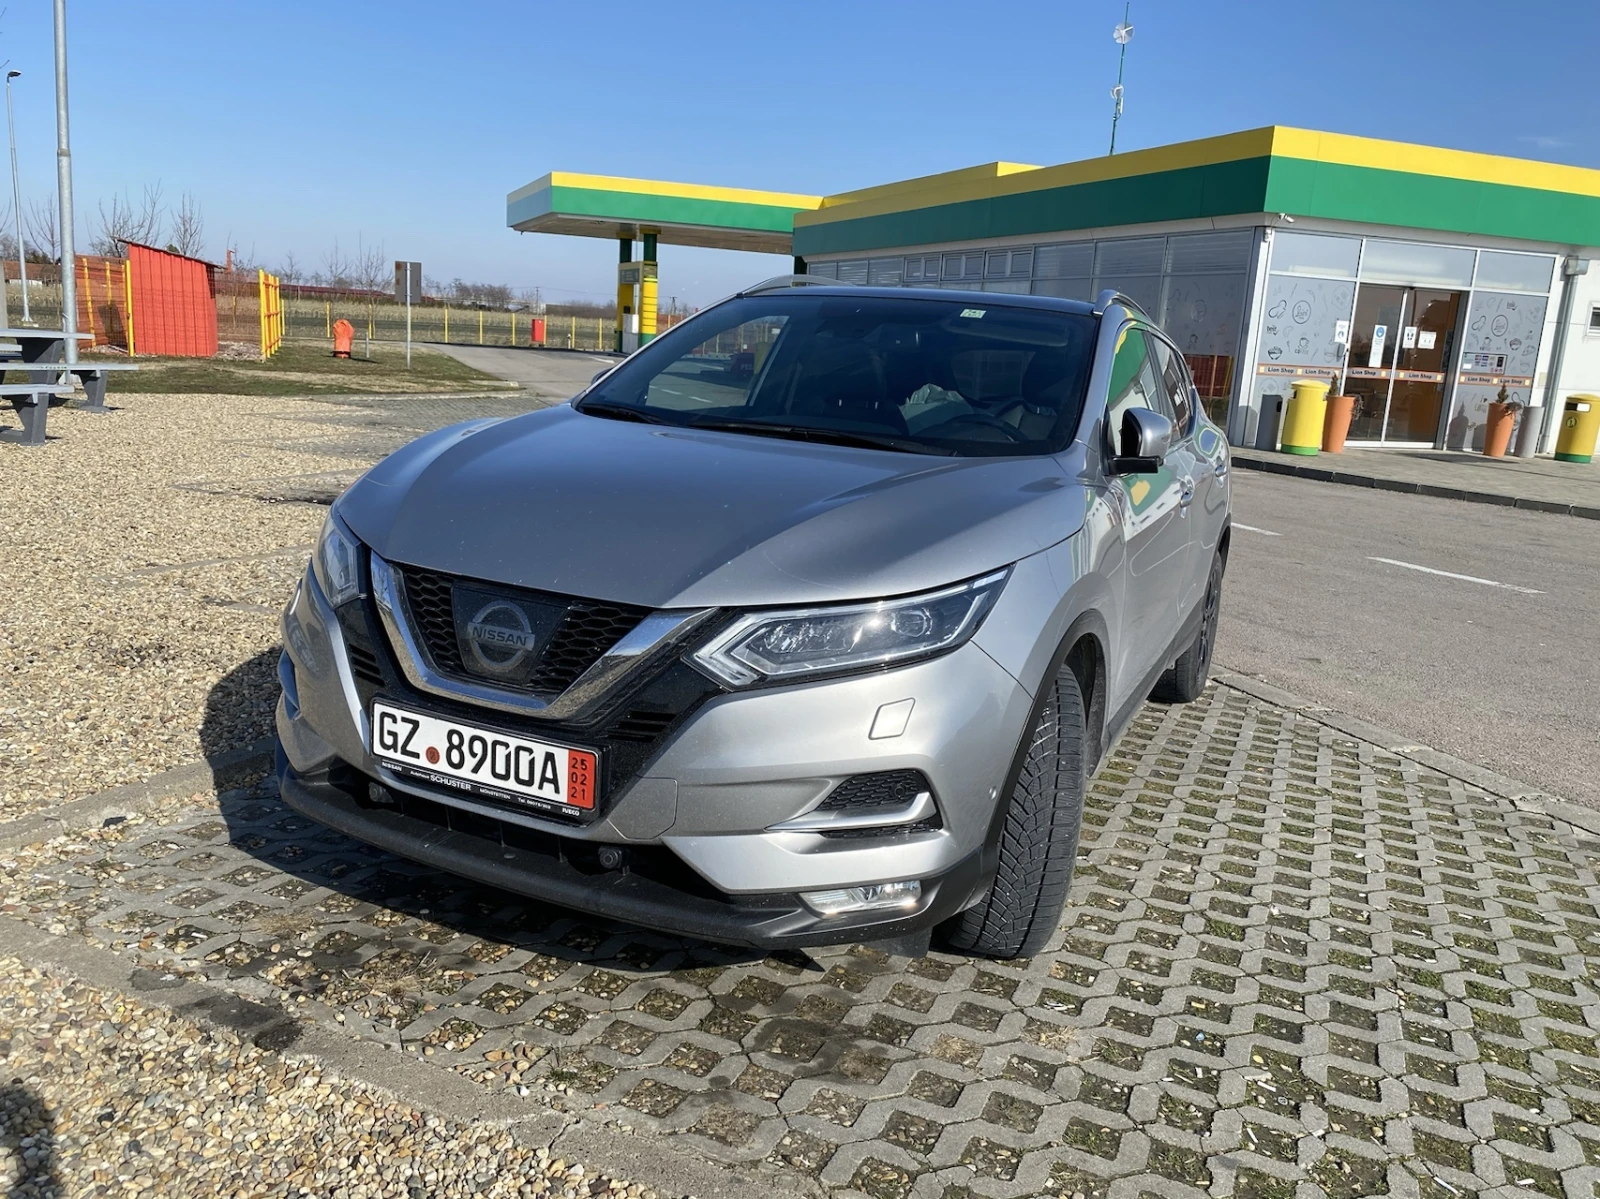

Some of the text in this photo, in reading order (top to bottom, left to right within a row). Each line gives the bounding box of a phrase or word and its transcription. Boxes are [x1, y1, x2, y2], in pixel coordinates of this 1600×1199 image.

[472, 626, 527, 647] NISSAN
[379, 711, 561, 795] GZ 8900A
[571, 756, 588, 771] 25
[571, 771, 588, 785] 02
[381, 761, 403, 772] NISSAN
[430, 773, 472, 792] SCHUSTER
[562, 807, 580, 817] IVECO
[571, 786, 587, 801] 21
